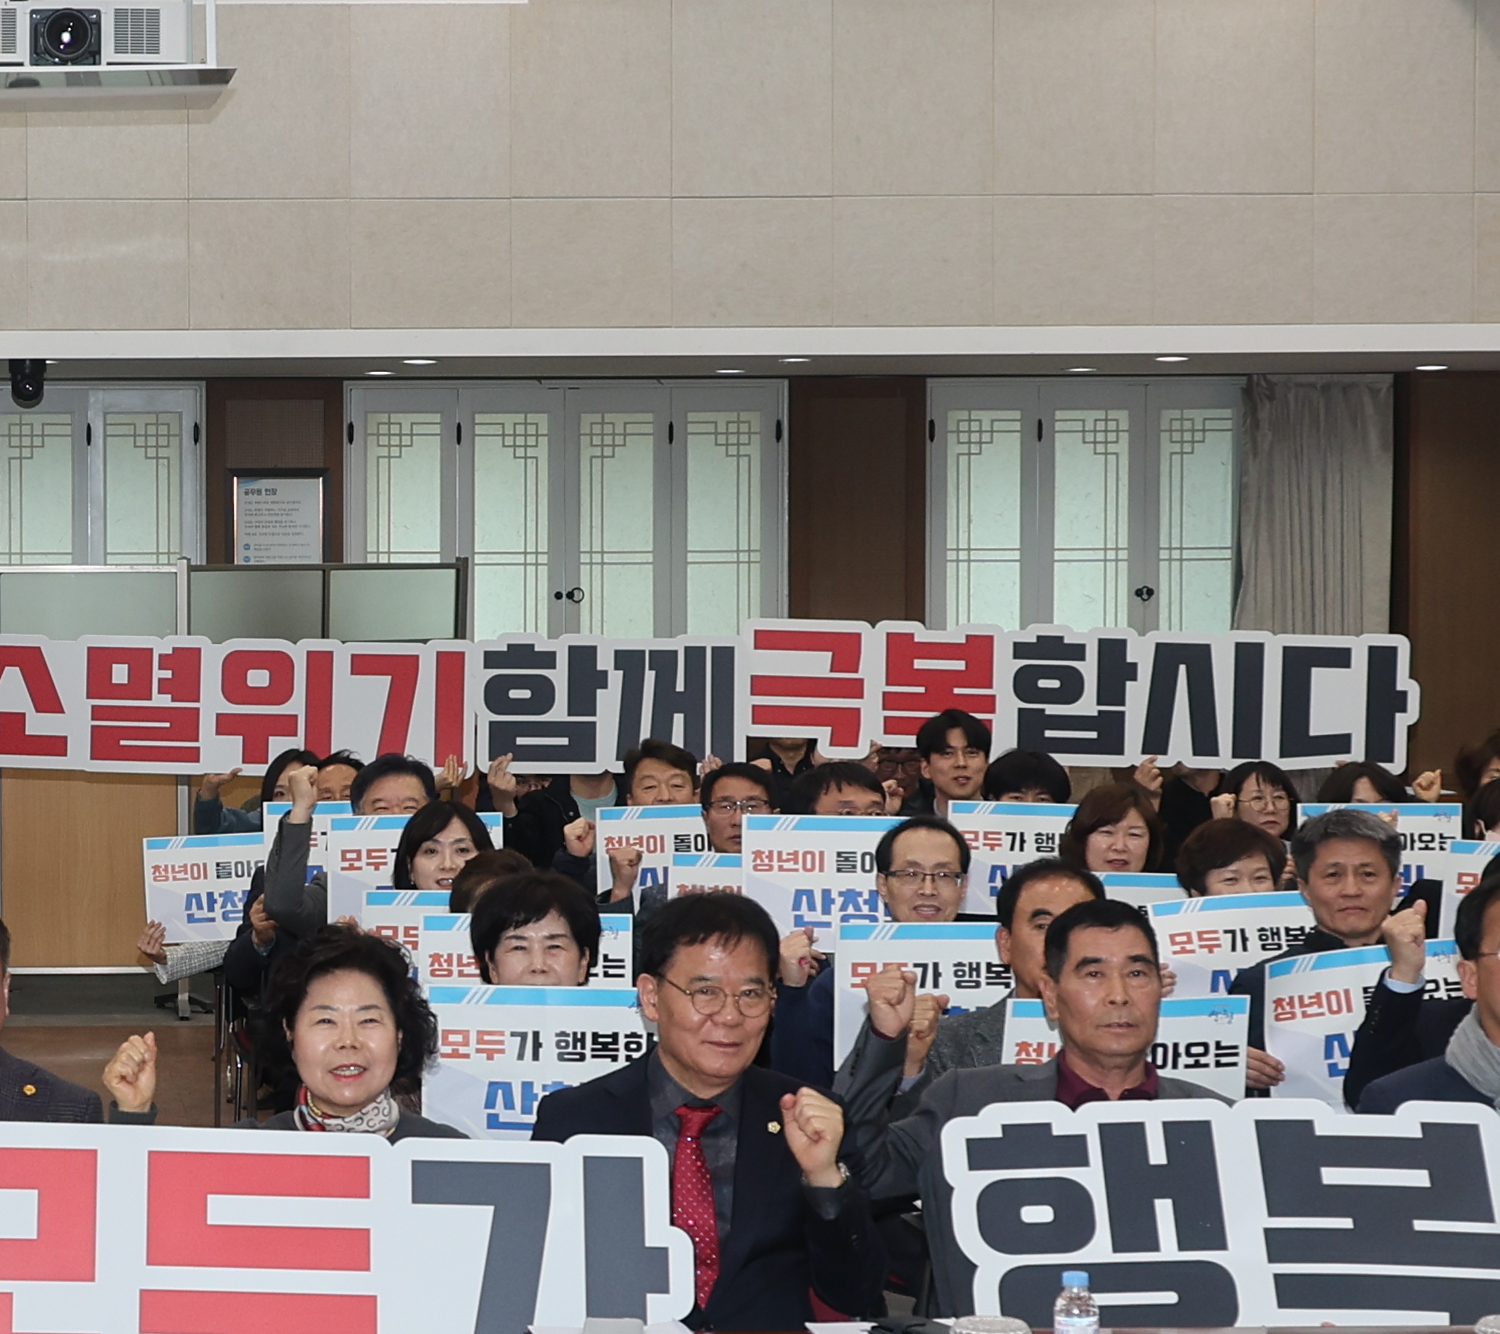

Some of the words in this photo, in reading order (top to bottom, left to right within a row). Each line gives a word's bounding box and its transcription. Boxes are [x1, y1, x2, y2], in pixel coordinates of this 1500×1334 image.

[1401, 831, 1456, 853] 아오는
[151, 862, 208, 882] 청년이
[340, 848, 397, 871] 모두
[752, 849, 825, 873] 청년이
[184, 890, 249, 924] 산청
[1169, 927, 1248, 955] 모두가
[1258, 925, 1314, 953] 행복
[429, 953, 481, 978] 청년
[953, 961, 1013, 989] 행복
[1273, 988, 1353, 1022] 청년이
[440, 1029, 543, 1061] 모두가
[1154, 1041, 1240, 1070] 아오는
